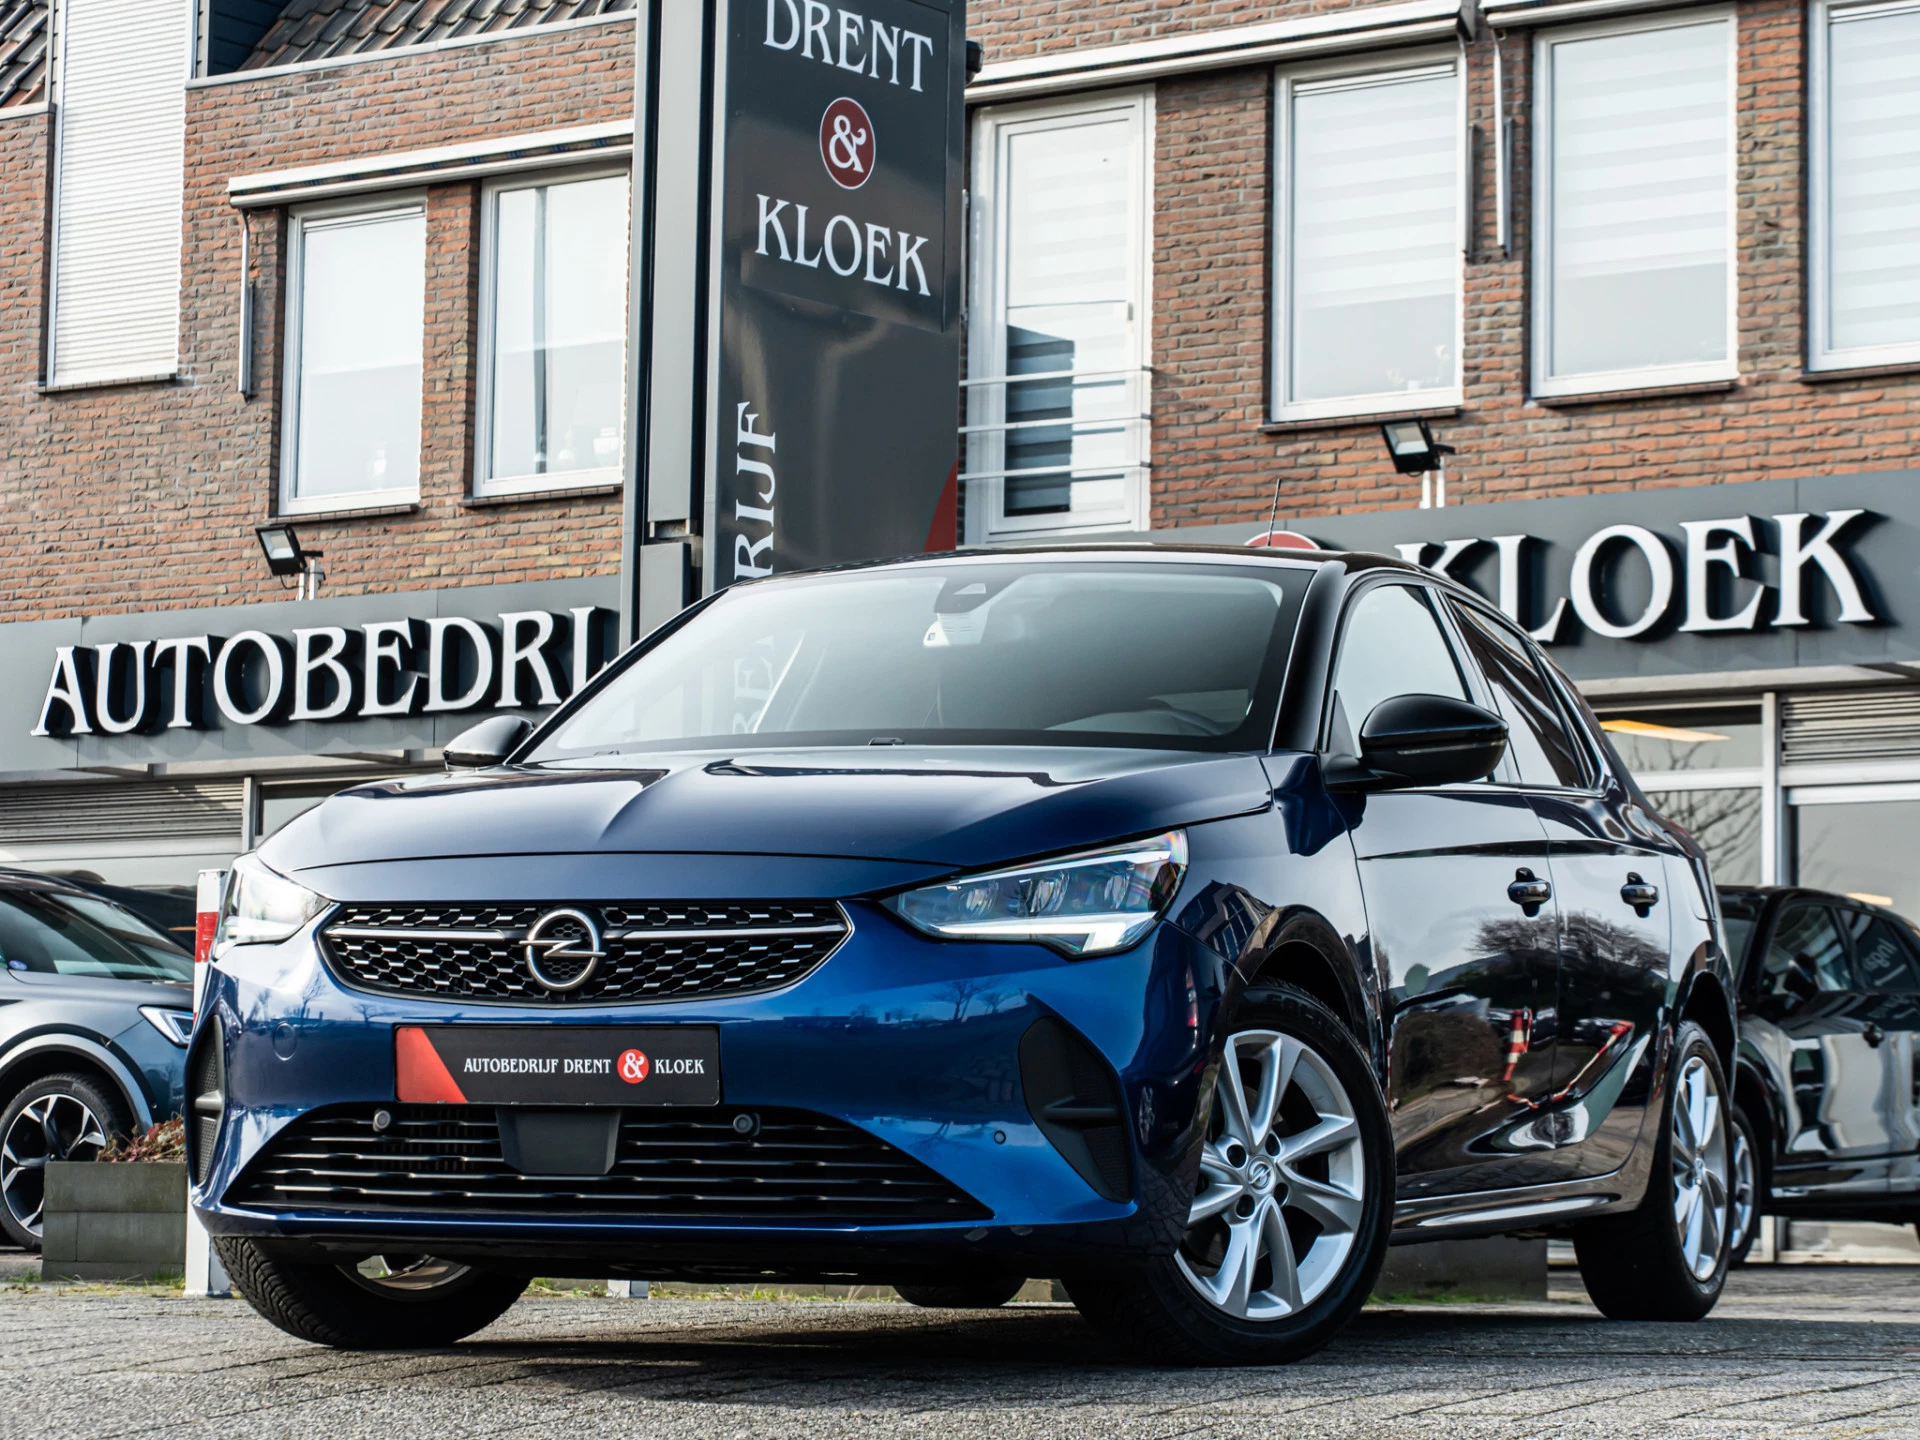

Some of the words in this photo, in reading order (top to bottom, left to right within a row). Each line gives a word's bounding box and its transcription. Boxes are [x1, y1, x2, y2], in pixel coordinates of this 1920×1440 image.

[763, 0, 934, 92] DRENT
[828, 114, 867, 173] &
[755, 193, 931, 296] KLOEK
[31, 606, 609, 737] AUTOBEDRI
[464, 1058, 559, 1074] AUTOBEDRIJF
[563, 1058, 612, 1074] DRENT
[623, 1052, 644, 1079] &
[655, 1059, 705, 1074] KLOEK
